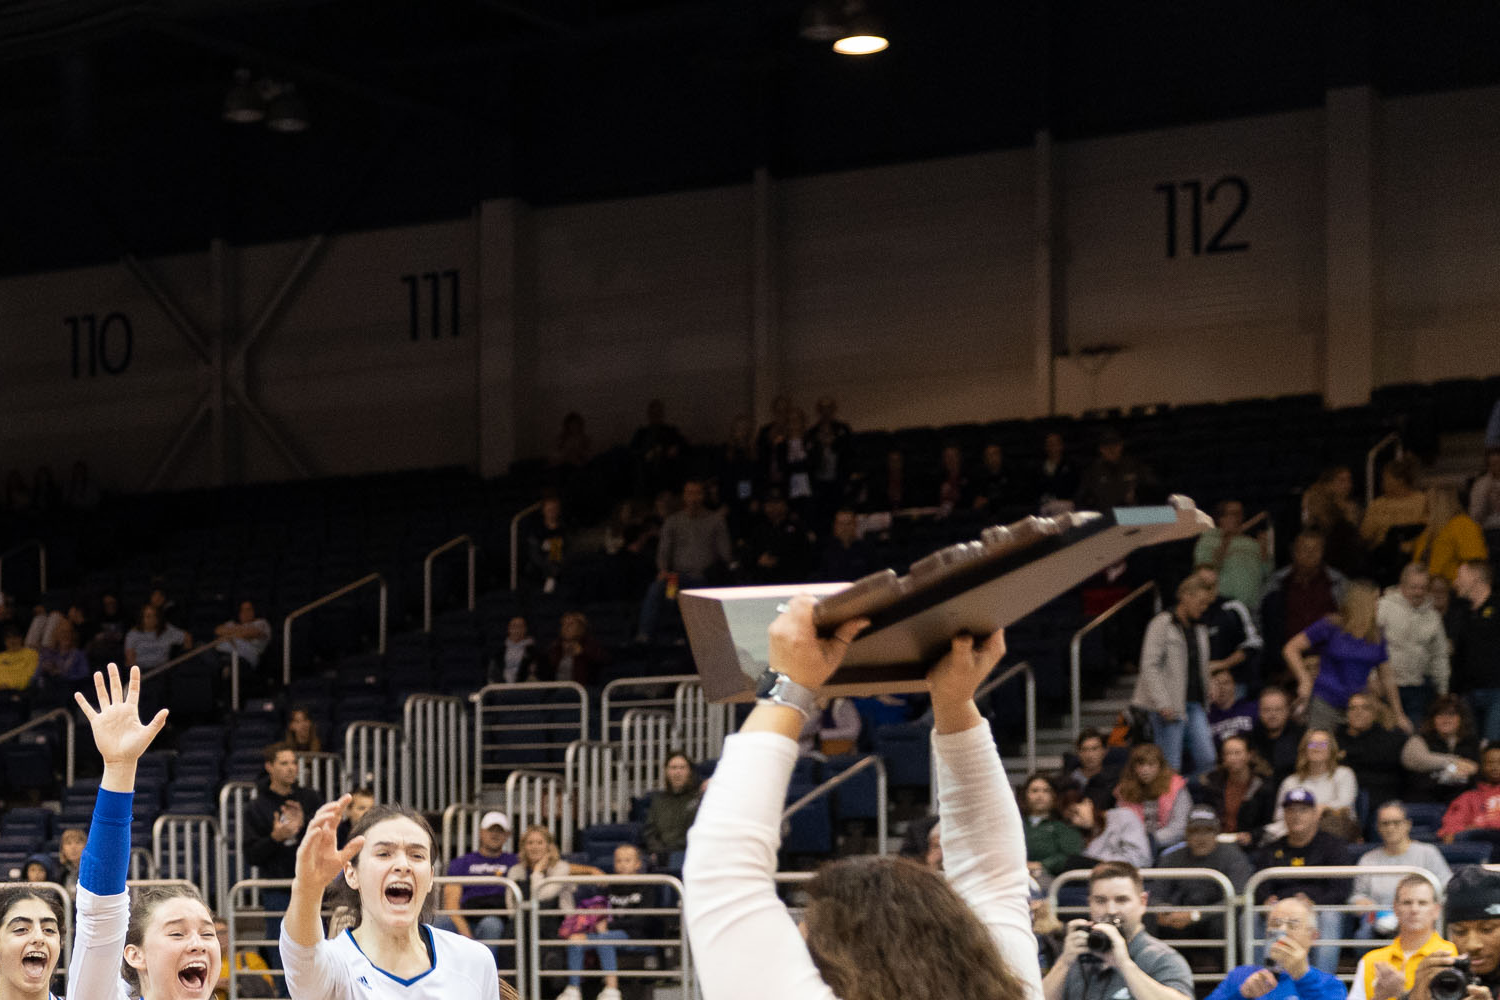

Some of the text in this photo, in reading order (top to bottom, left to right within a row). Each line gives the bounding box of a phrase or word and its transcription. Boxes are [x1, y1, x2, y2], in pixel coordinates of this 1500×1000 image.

[1155, 175, 1251, 258] 112
[399, 267, 461, 342] 111
[63, 311, 134, 378] 110
